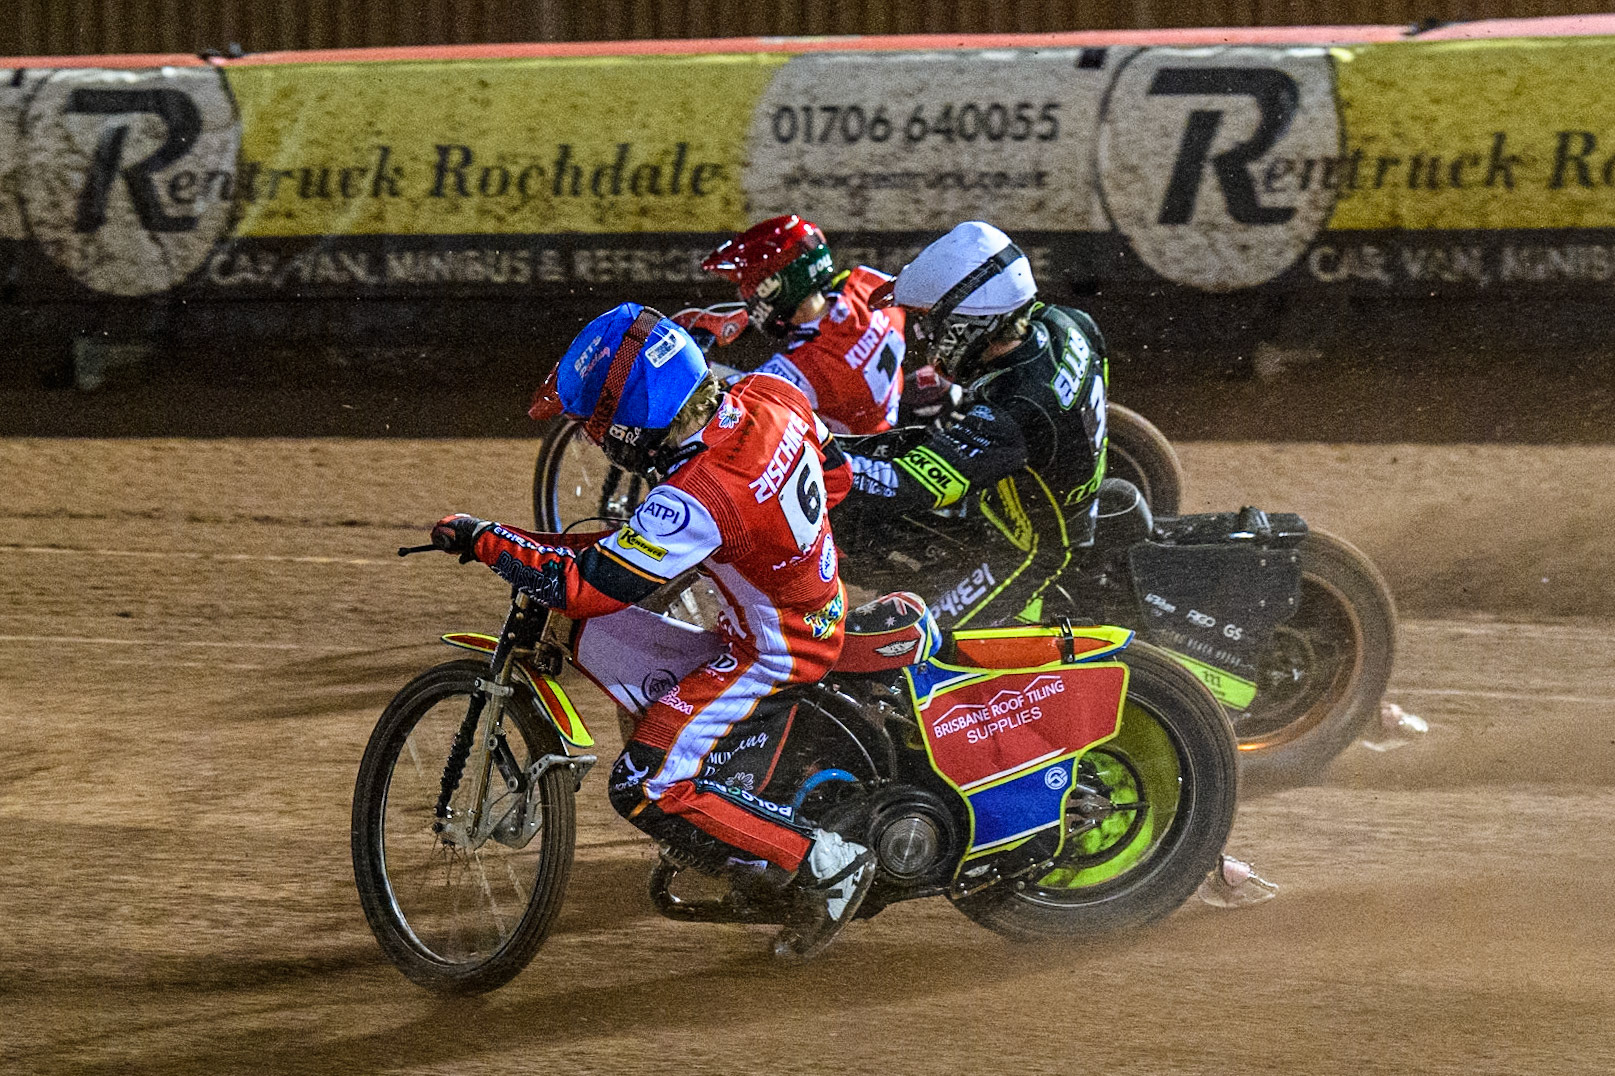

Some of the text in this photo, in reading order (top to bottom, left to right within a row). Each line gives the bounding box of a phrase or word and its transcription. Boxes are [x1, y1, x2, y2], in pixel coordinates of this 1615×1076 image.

[772, 101, 1060, 144] 01706 640055
[430, 142, 727, 199] Rochdale
[844, 309, 890, 370] KURTZ
[876, 343, 897, 381] 1
[1053, 327, 1091, 407] ELLIS
[796, 462, 823, 527] 6
[927, 465, 953, 490] OIL
[643, 501, 680, 525] ATPI
[620, 529, 662, 558] Rentruck
[934, 680, 1065, 739] BRISBANE ROOF TILING
[966, 706, 1043, 744] SUPPLIES
